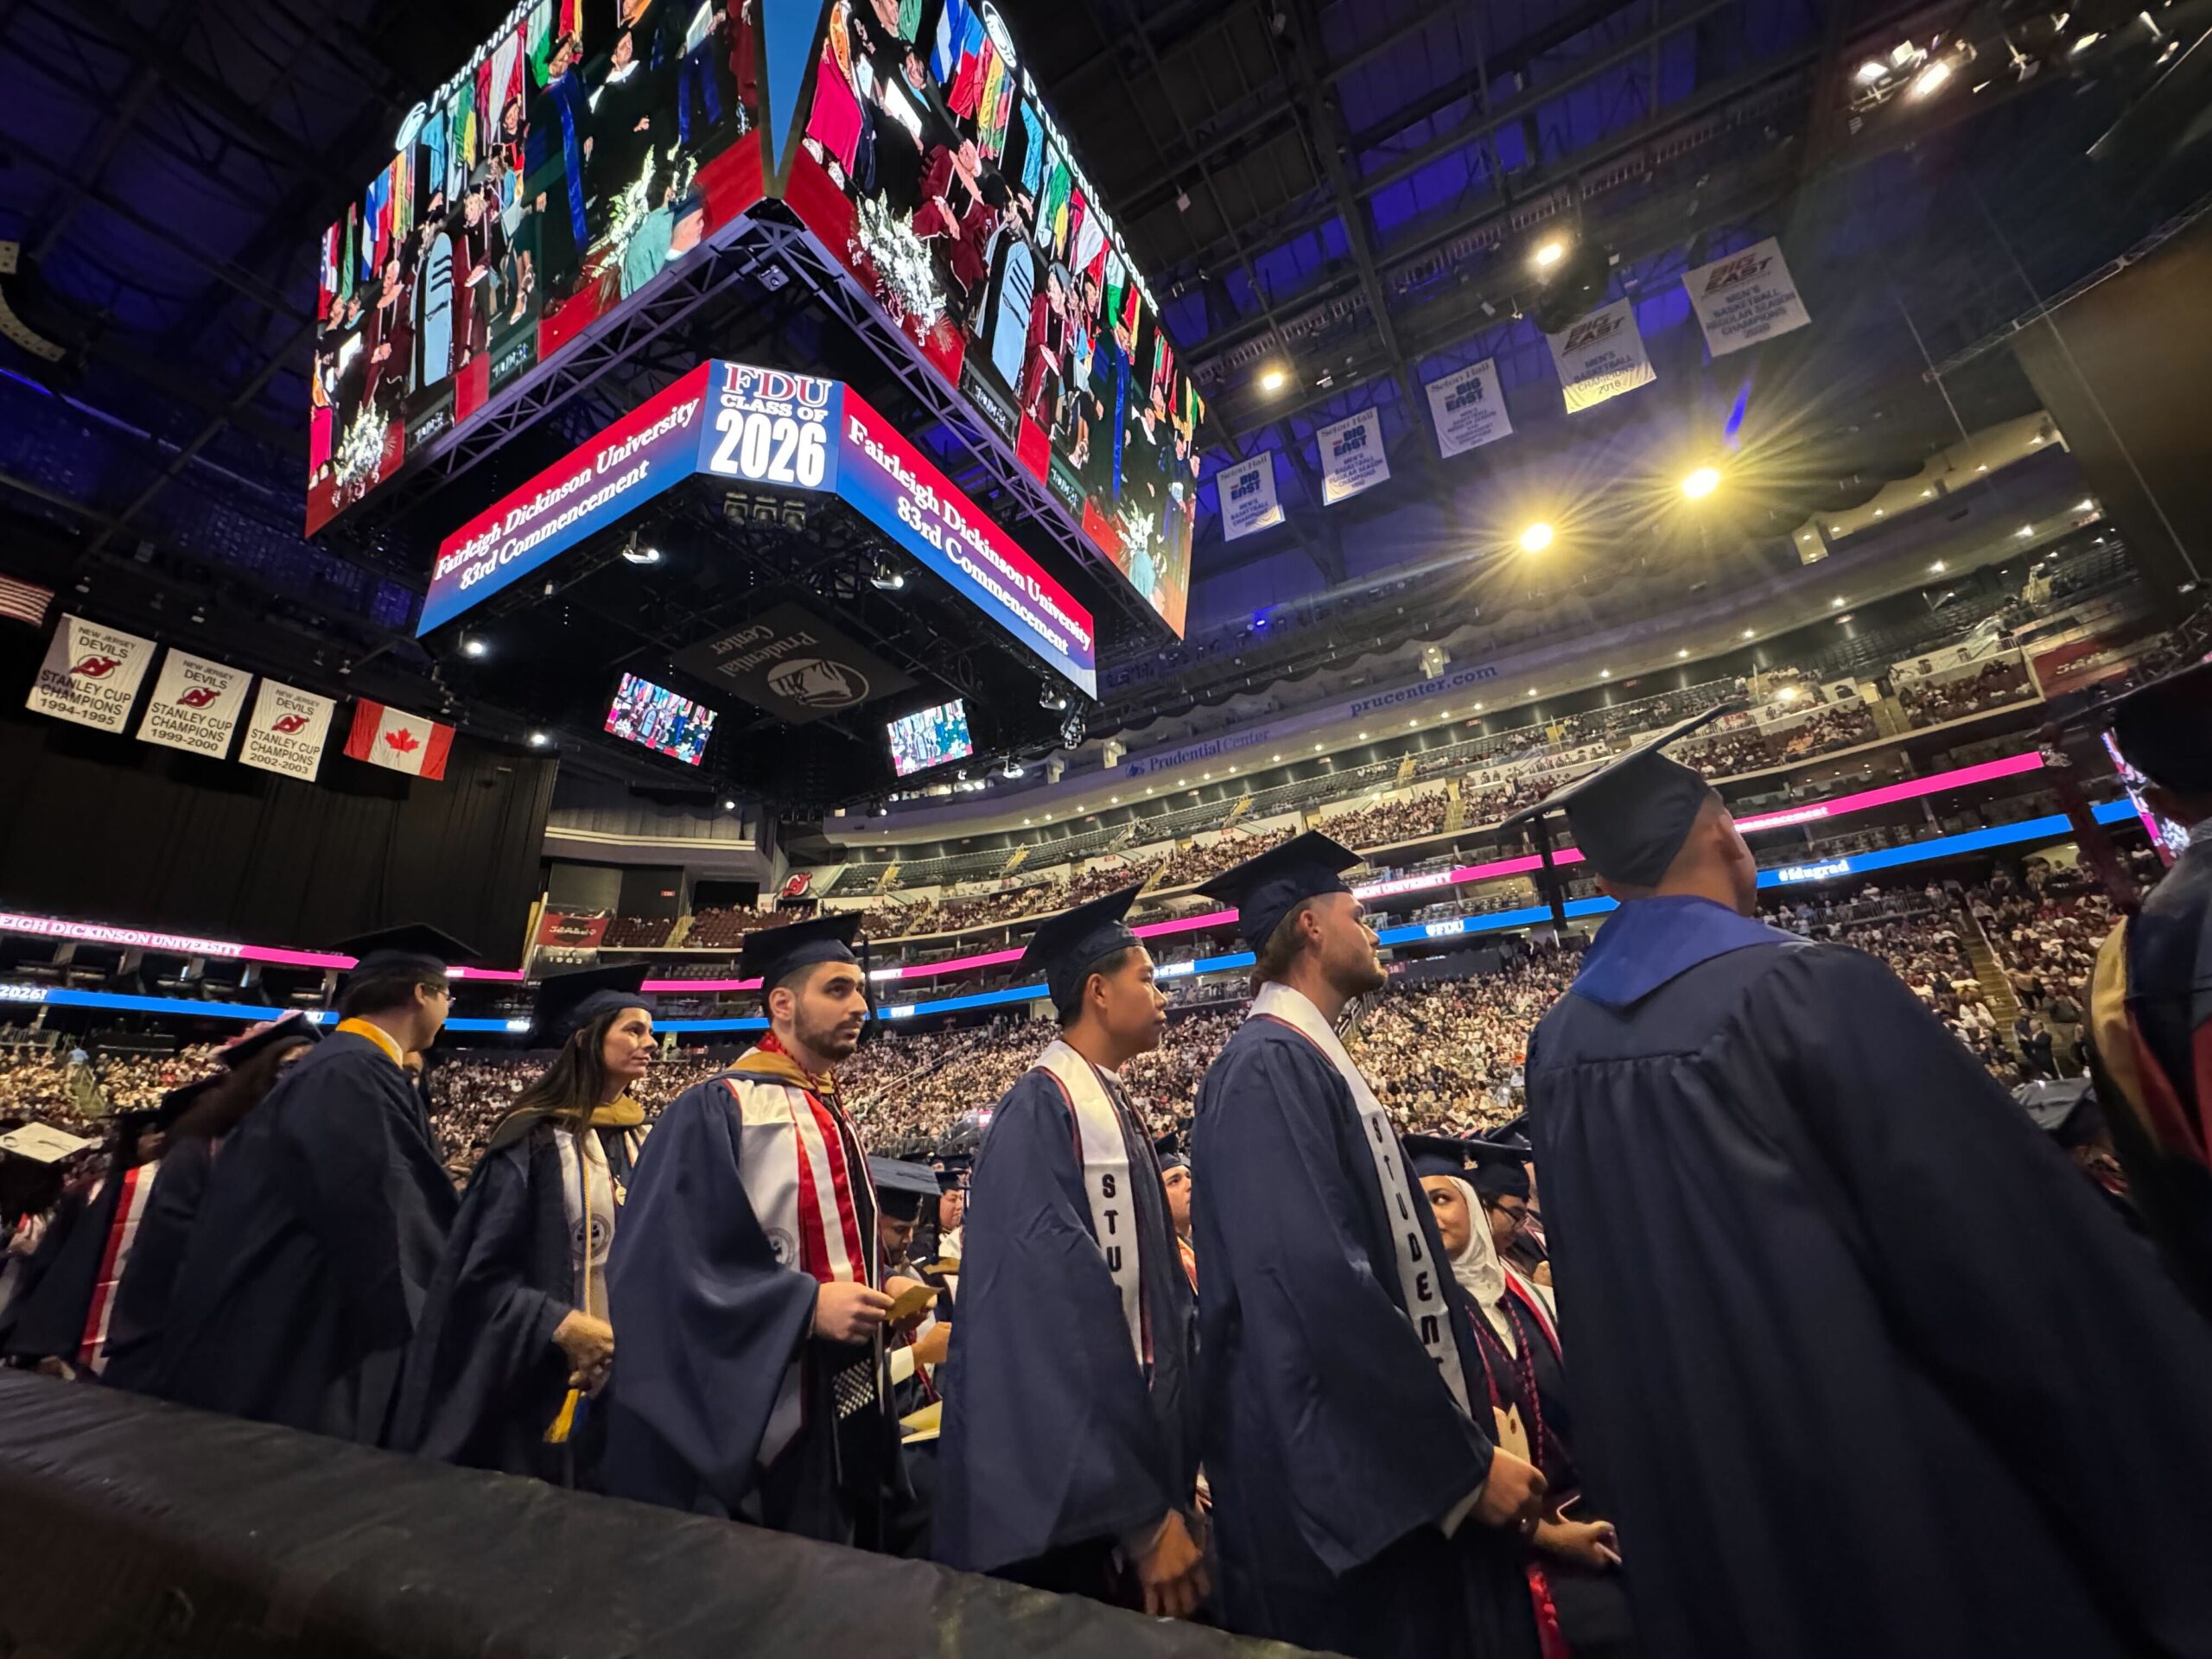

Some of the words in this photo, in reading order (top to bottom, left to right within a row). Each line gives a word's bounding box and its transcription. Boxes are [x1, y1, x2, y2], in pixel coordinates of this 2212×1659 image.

[1023, 67, 1113, 239] Prudential
[1114, 232, 1160, 317] Center
[1564, 317, 1624, 350] EAST
[1571, 313, 1611, 332] BIG
[1574, 355, 1633, 383] BASKETBALL
[1578, 364, 1635, 392] CHAMPIONS
[722, 362, 833, 407] FDU
[1598, 379, 1621, 394] 2016
[721, 393, 793, 416] CLASS
[797, 406, 829, 423] OF
[710, 408, 827, 487] 2026
[434, 524, 500, 581] Fairleigh
[503, 468, 592, 536] Dickinson
[596, 398, 699, 474] University
[1230, 480, 1261, 500] EAST
[1240, 469, 1260, 486] BIG
[460, 556, 498, 590] 83rd
[499, 459, 650, 565] Commencement
[848, 415, 941, 517] Fairleigh
[943, 499, 1026, 591] Dickinson
[1026, 575, 1091, 651] University
[897, 496, 943, 550] 83rd
[945, 537, 1069, 656] Commencement
[78, 626, 101, 639] NEW
[102, 634, 136, 650] JERSEY
[79, 636, 129, 658] DEVILS
[709, 624, 775, 655] Center
[716, 631, 819, 677] Prudential
[183, 659, 203, 671] NEW
[204, 667, 234, 680] JERSEY
[184, 670, 227, 690] DEVILS
[41, 670, 102, 696] STANLEY
[104, 688, 132, 703] CUP
[41, 684, 123, 715] CHAMPIONS
[276, 689, 293, 699] NEW
[294, 696, 321, 707] JERSEY
[1350, 666, 1498, 717] prucenter.com
[40, 698, 116, 725] 1994-1995
[151, 702, 207, 724] STANLEY
[207, 717, 232, 730] CUP
[276, 697, 315, 715] DEVILS
[150, 728, 218, 752] 1999-2000
[151, 715, 225, 742] CHAMPIONS
[251, 728, 297, 749] STANLEY
[299, 743, 321, 755] CUP
[249, 753, 308, 774] 2002-2003
[250, 741, 315, 766] CHAMPIONS
[1150, 740, 1220, 771] Prudential
[1223, 730, 1270, 750] Center
[1778, 859, 1850, 882] #fdugrad
[48, 921, 150, 944] DICKINSON
[151, 936, 244, 955] UNIVERSITY
[0, 986, 48, 1000] 2026!
[1102, 1173, 1122, 1300] STU
